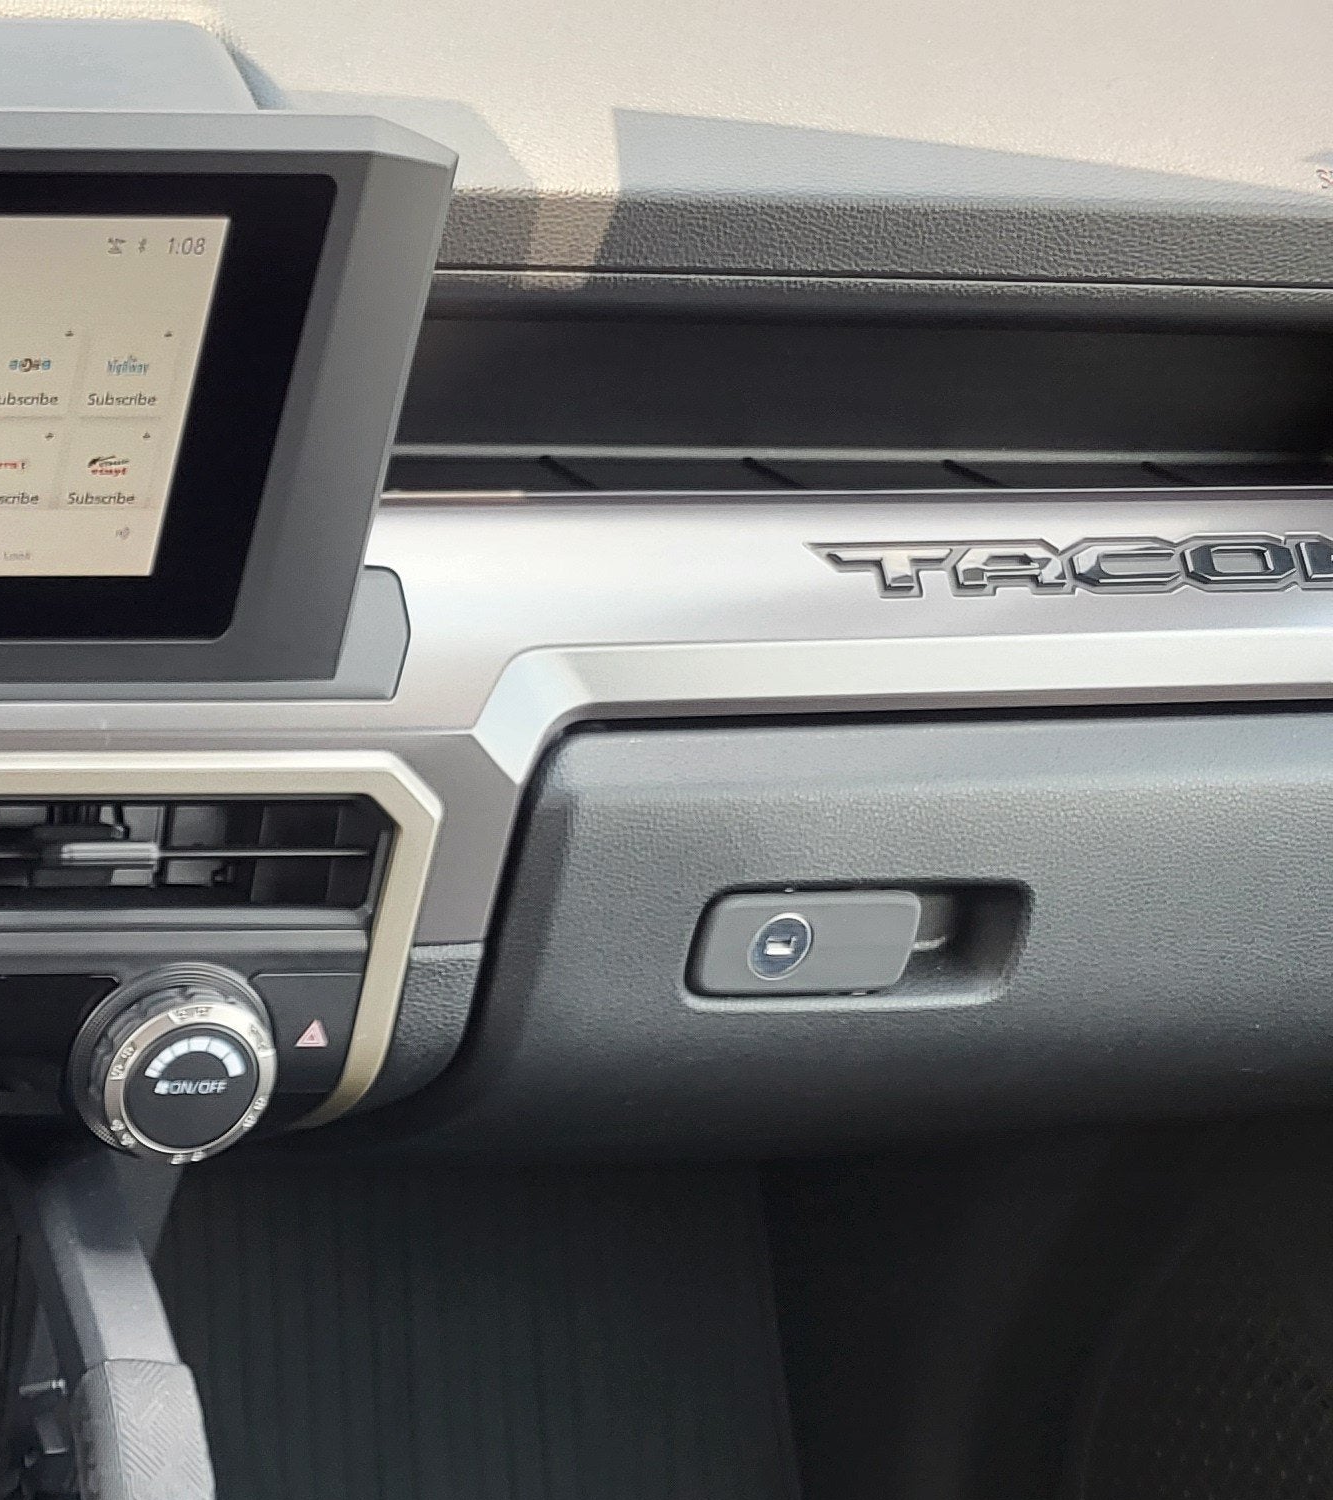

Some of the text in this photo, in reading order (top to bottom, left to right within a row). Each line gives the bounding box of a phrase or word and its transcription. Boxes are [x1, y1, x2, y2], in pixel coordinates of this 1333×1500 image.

[167, 237, 206, 255] 1:08
[87, 392, 157, 406] Subscribe
[67, 491, 135, 506] Subscribe
[169, 1079, 227, 1094] ON/OFF
